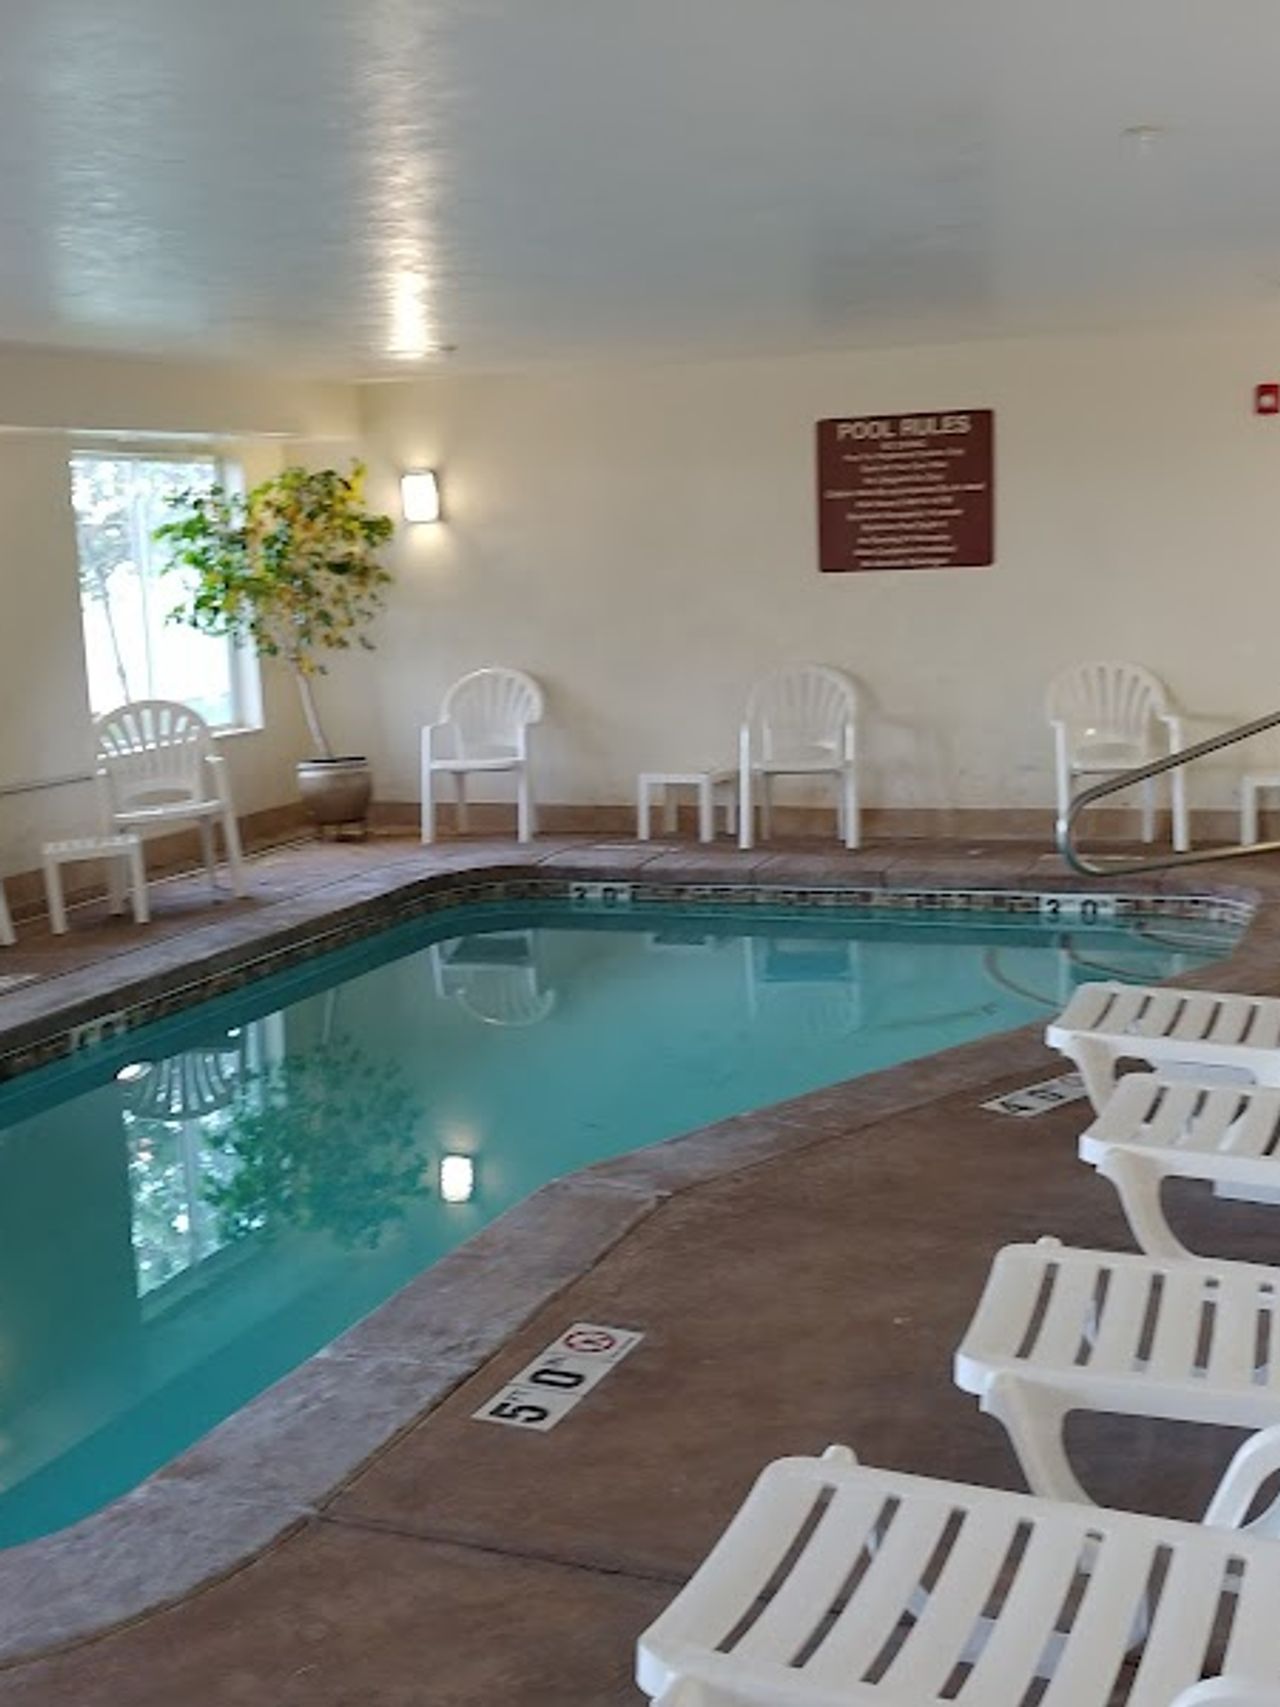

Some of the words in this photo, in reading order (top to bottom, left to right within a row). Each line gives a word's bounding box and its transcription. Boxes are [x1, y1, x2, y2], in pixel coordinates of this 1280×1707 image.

[836, 421, 896, 440] POOL
[899, 415, 971, 436] RULES
[489, 1402, 550, 1423] 5
[528, 1368, 586, 1389] 0
